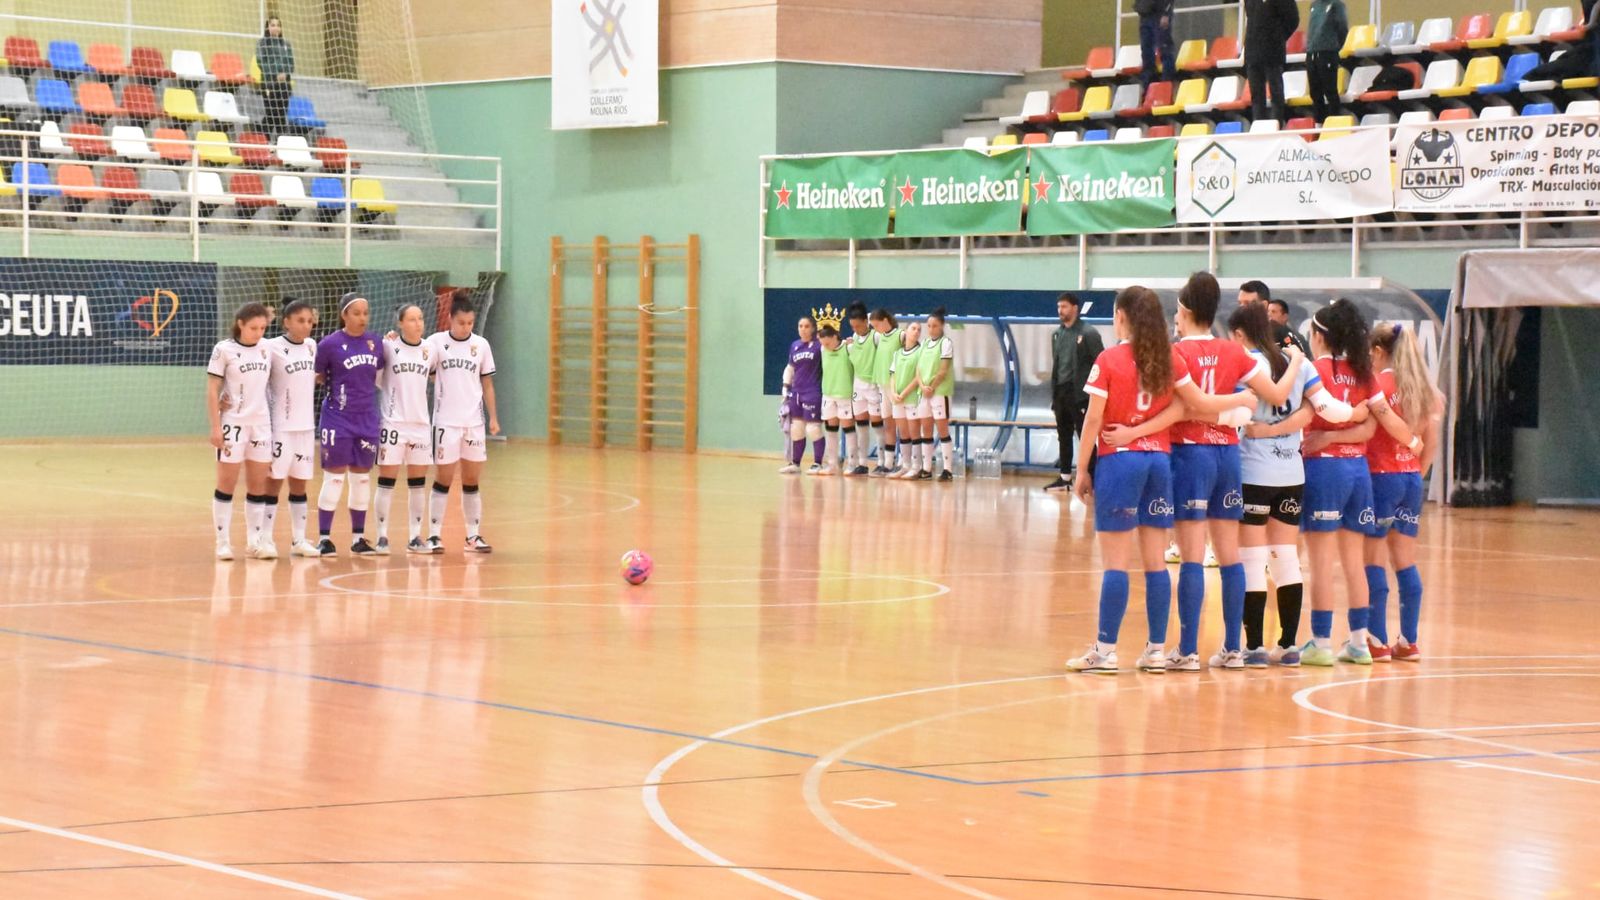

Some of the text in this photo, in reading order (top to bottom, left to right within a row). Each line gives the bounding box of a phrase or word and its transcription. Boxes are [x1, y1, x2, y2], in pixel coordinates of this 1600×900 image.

[1466, 125, 1533, 142] CENTRO
[1490, 149, 1538, 163] Spinning
[1553, 147, 1582, 160] Body
[1247, 169, 1313, 184] SANTAELLA
[1318, 170, 1325, 183] Y
[1470, 166, 1535, 181] Oposiciones
[1549, 163, 1579, 176] Artes
[922, 175, 1019, 206] Heineken
[1198, 175, 1230, 191] S&O
[796, 182, 885, 209] Heineken
[1299, 191, 1317, 203] S.L.
[240, 361, 267, 373] CEUTA
[284, 359, 315, 375] CEUT
[343, 353, 378, 370] CEUTA
[392, 361, 429, 377] CEUTA
[441, 358, 477, 374] CEUTA
[223, 424, 241, 442] 27
[321, 428, 336, 446] 91
[380, 428, 399, 446] 99
